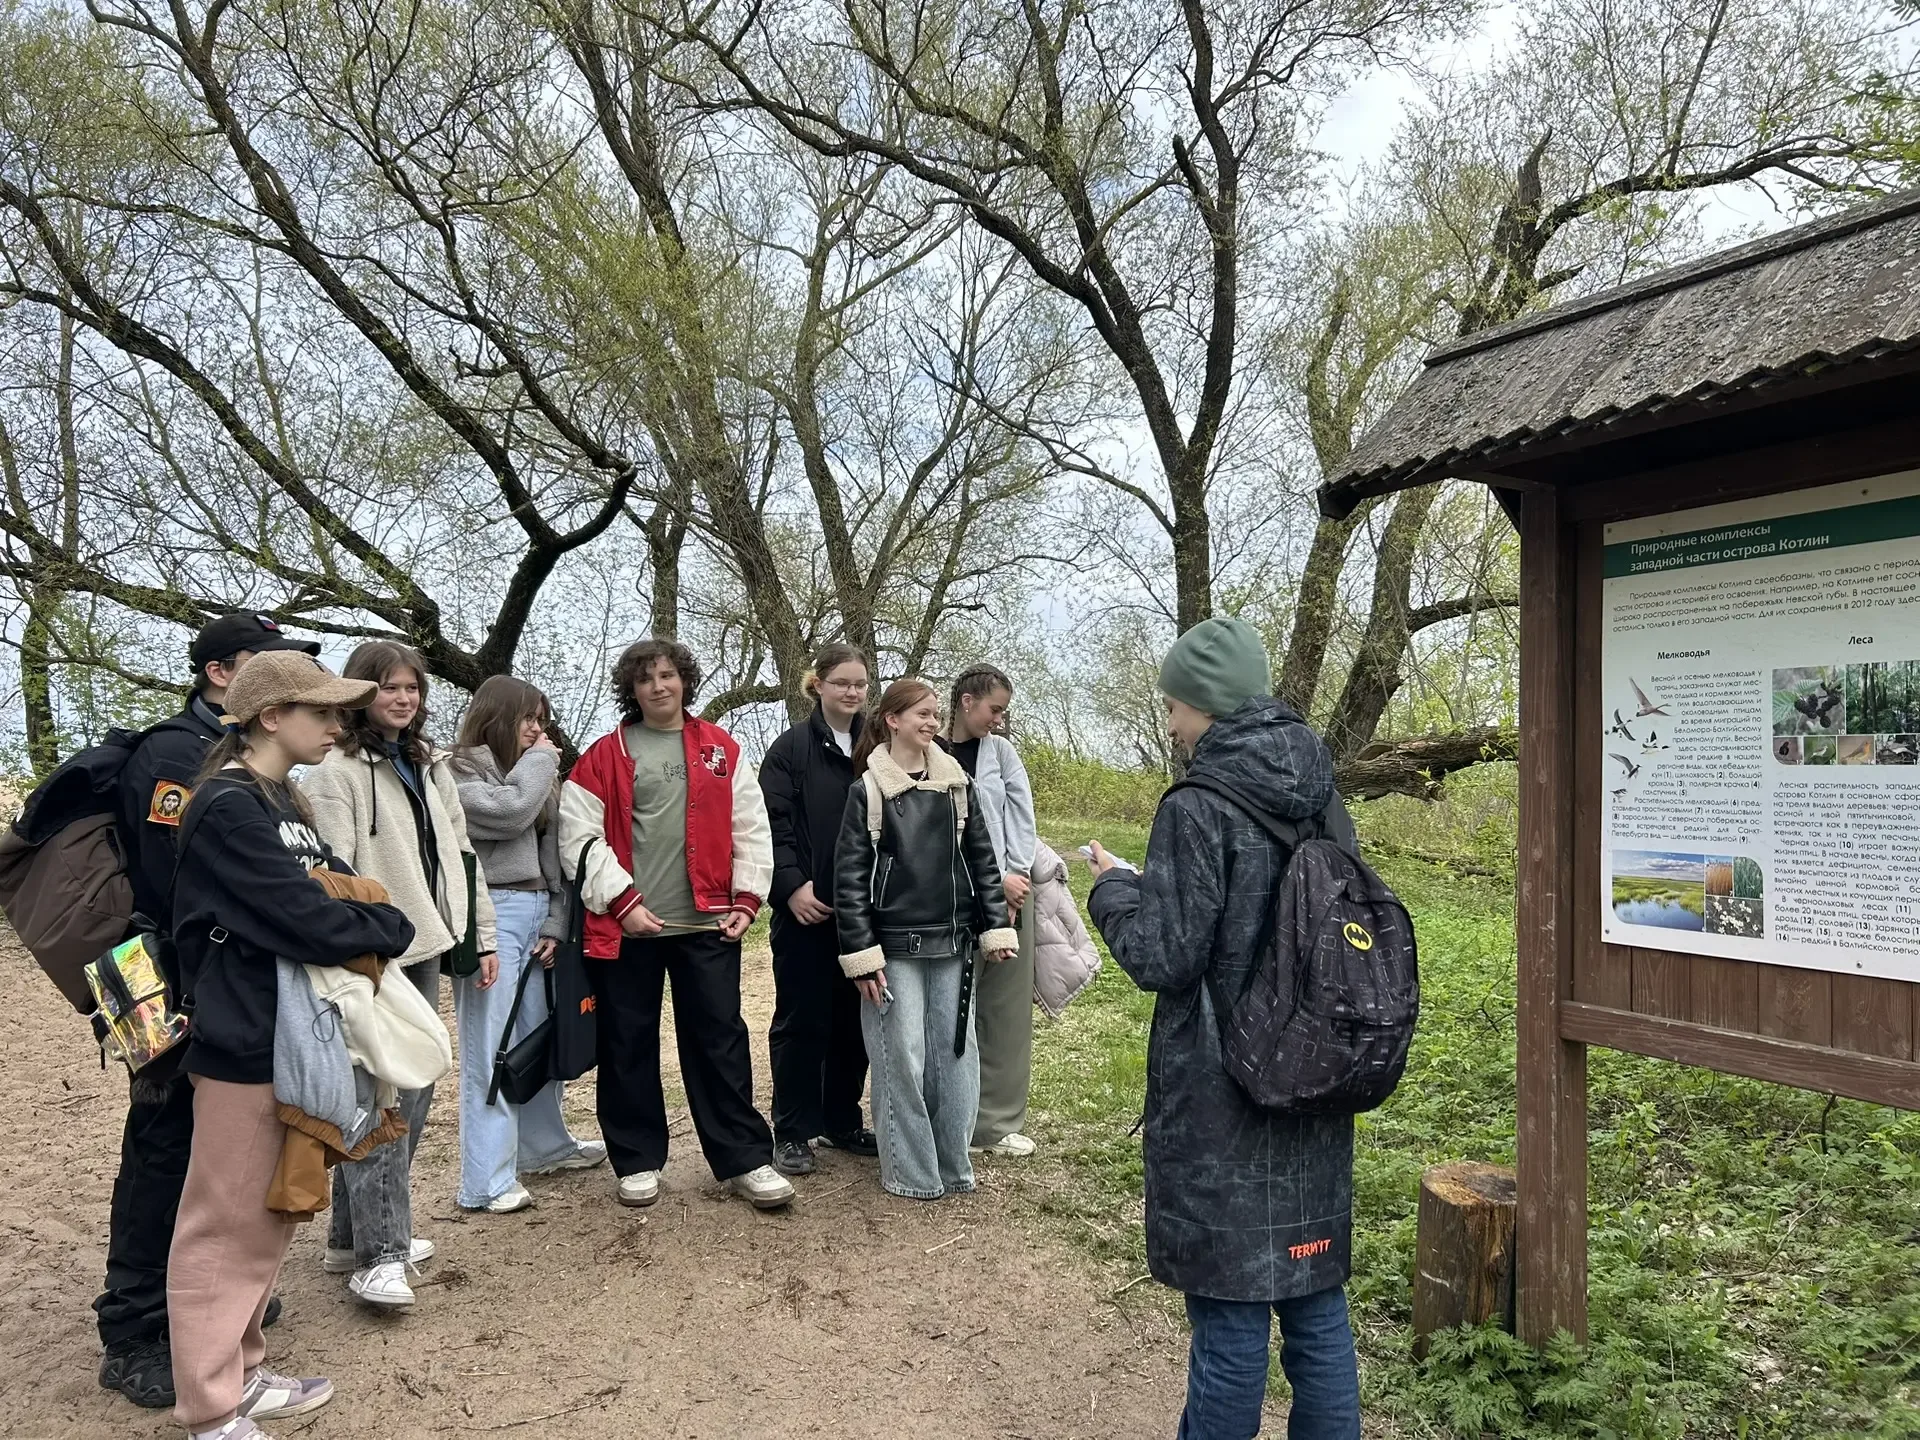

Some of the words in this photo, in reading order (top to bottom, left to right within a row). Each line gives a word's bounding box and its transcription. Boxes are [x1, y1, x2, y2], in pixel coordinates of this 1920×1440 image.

[1631, 536, 1697, 556] Природные
[1700, 526, 1770, 544] комплексы
[1630, 554, 1684, 572] западной
[1686, 550, 1720, 563] части
[1723, 543, 1776, 558] острова
[1780, 535, 1830, 551] Котлин
[1630, 590, 1671, 600] Природные
[1673, 584, 1716, 594] комплексы
[1719, 580, 1752, 589] Котлина
[1835, 565, 1871, 575] связано
[1634, 601, 1664, 610] острова
[1672, 594, 1709, 604] историей
[1837, 577, 1874, 586] Котлине
[1877, 574, 1892, 582] нет
[1613, 614, 1640, 622] широко
[1642, 606, 1716, 619] распространенных
[1733, 599, 1784, 609] побережьях
[1786, 592, 1822, 603] Невской
[1860, 584, 1916, 595] настоящее
[1613, 624, 1644, 632] остались
[1647, 621, 1669, 629] только
[1691, 614, 1729, 624] западной
[1758, 610, 1773, 618] Для
[1788, 604, 1841, 615] сохранения
[1852, 599, 1871, 609] 2012
[1875, 598, 1894, 606] году
[1848, 636, 1873, 644] Леса
[1657, 650, 1710, 660] Мелководья
[1809, 791, 1836, 799] Котлин
[1847, 813, 1916, 821] пятитычинковой,
[1840, 841, 1854, 850] (10)
[1799, 870, 1848, 878] высыпаются
[1862, 873, 1892, 881] плодов
[1774, 877, 1807, 885] вычайно
[1816, 880, 1846, 888] ценной
[1856, 883, 1899, 891] кормовой
[1805, 889, 1840, 897] местных
[1850, 893, 1892, 901] кочующих
[1774, 904, 1800, 913] более
[1802, 904, 1811, 914] 20
[1813, 909, 1835, 917] видов
[1862, 913, 1888, 921] среди
[1794, 898, 1854, 908] черноольховых
[1896, 905, 1911, 915] (11)
[1775, 924, 1812, 934] рябинник
[1846, 932, 1871, 940] также
[1818, 919, 1853, 928] соловей
[1876, 925, 1910, 934] зарянка
[1776, 933, 1789, 942] (16)
[1802, 937, 1831, 945] редкий
[1840, 939, 1890, 952] Балтийском
